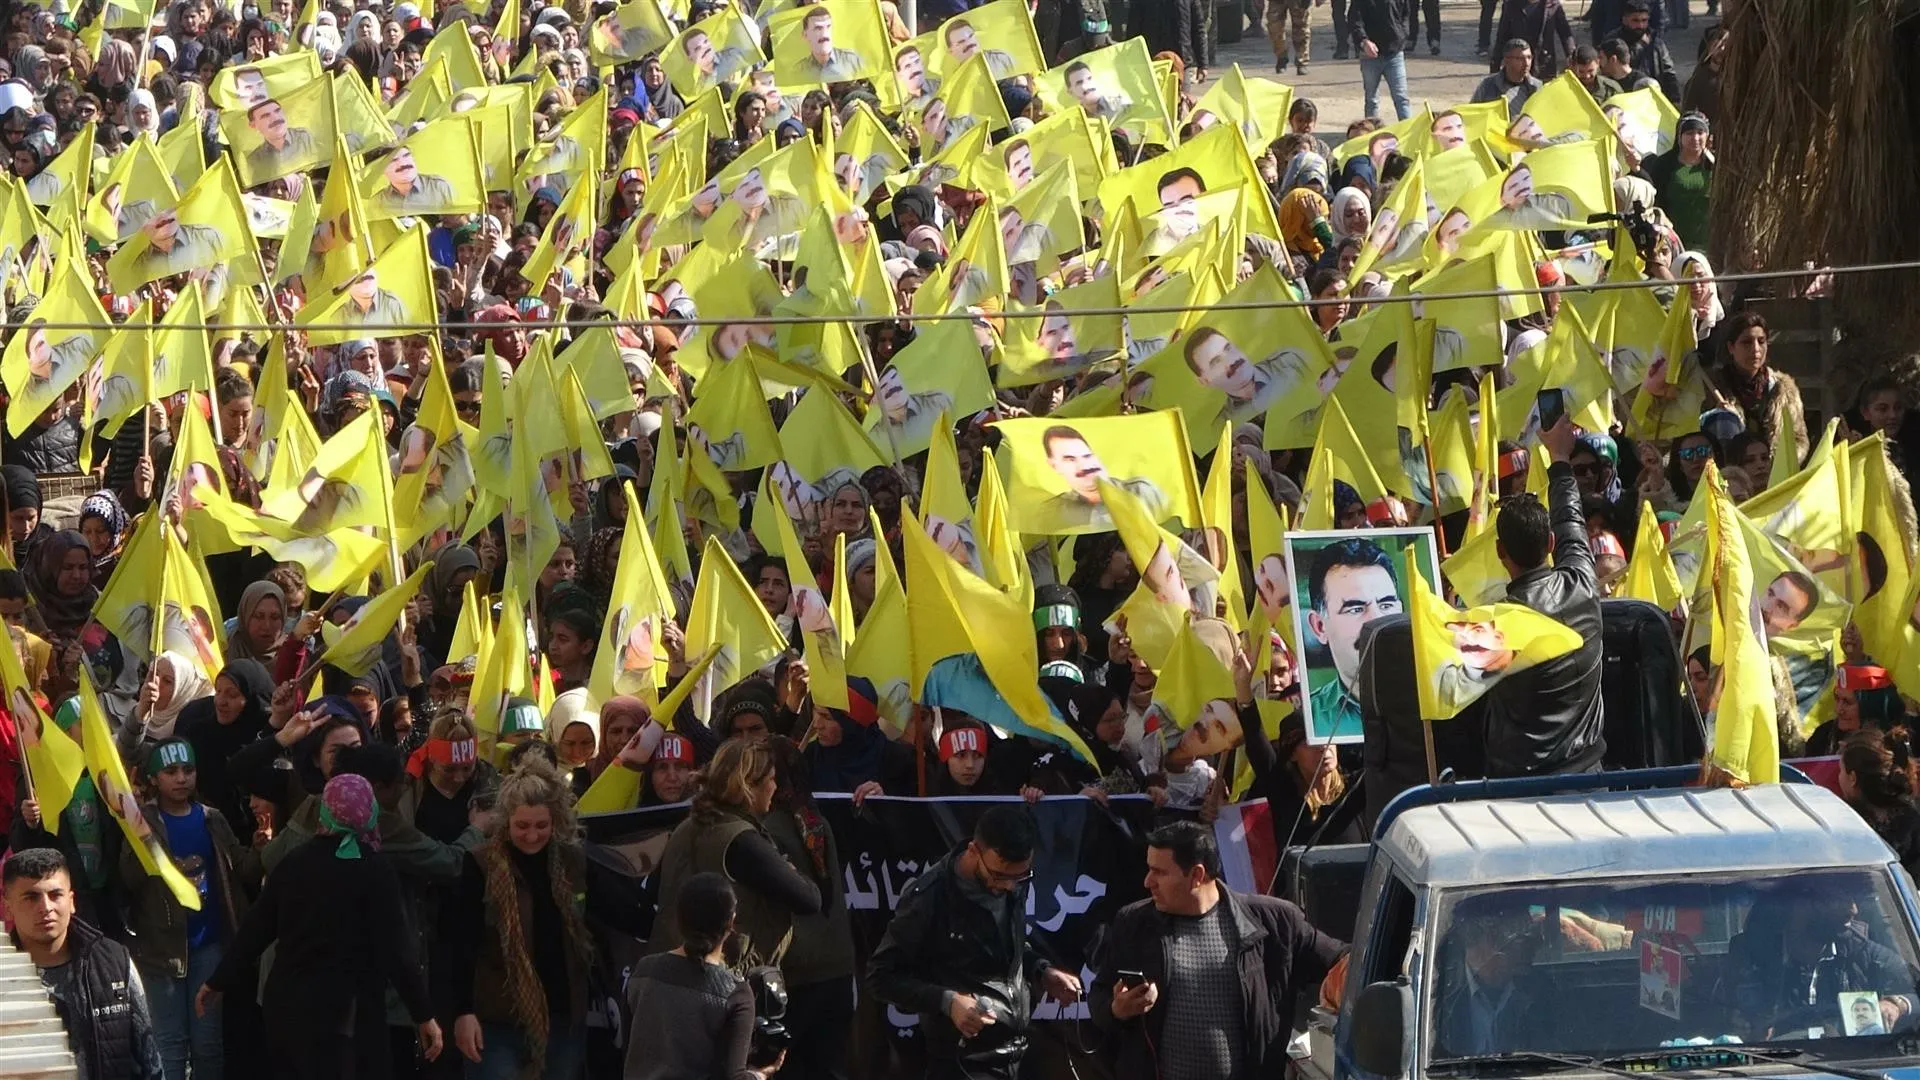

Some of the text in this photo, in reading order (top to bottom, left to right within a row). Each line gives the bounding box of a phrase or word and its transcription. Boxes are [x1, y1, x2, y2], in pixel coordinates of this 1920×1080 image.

[451, 738, 475, 763] APO
[655, 738, 681, 758] APO
[951, 730, 977, 753] APO
[160, 743, 188, 766] APO
